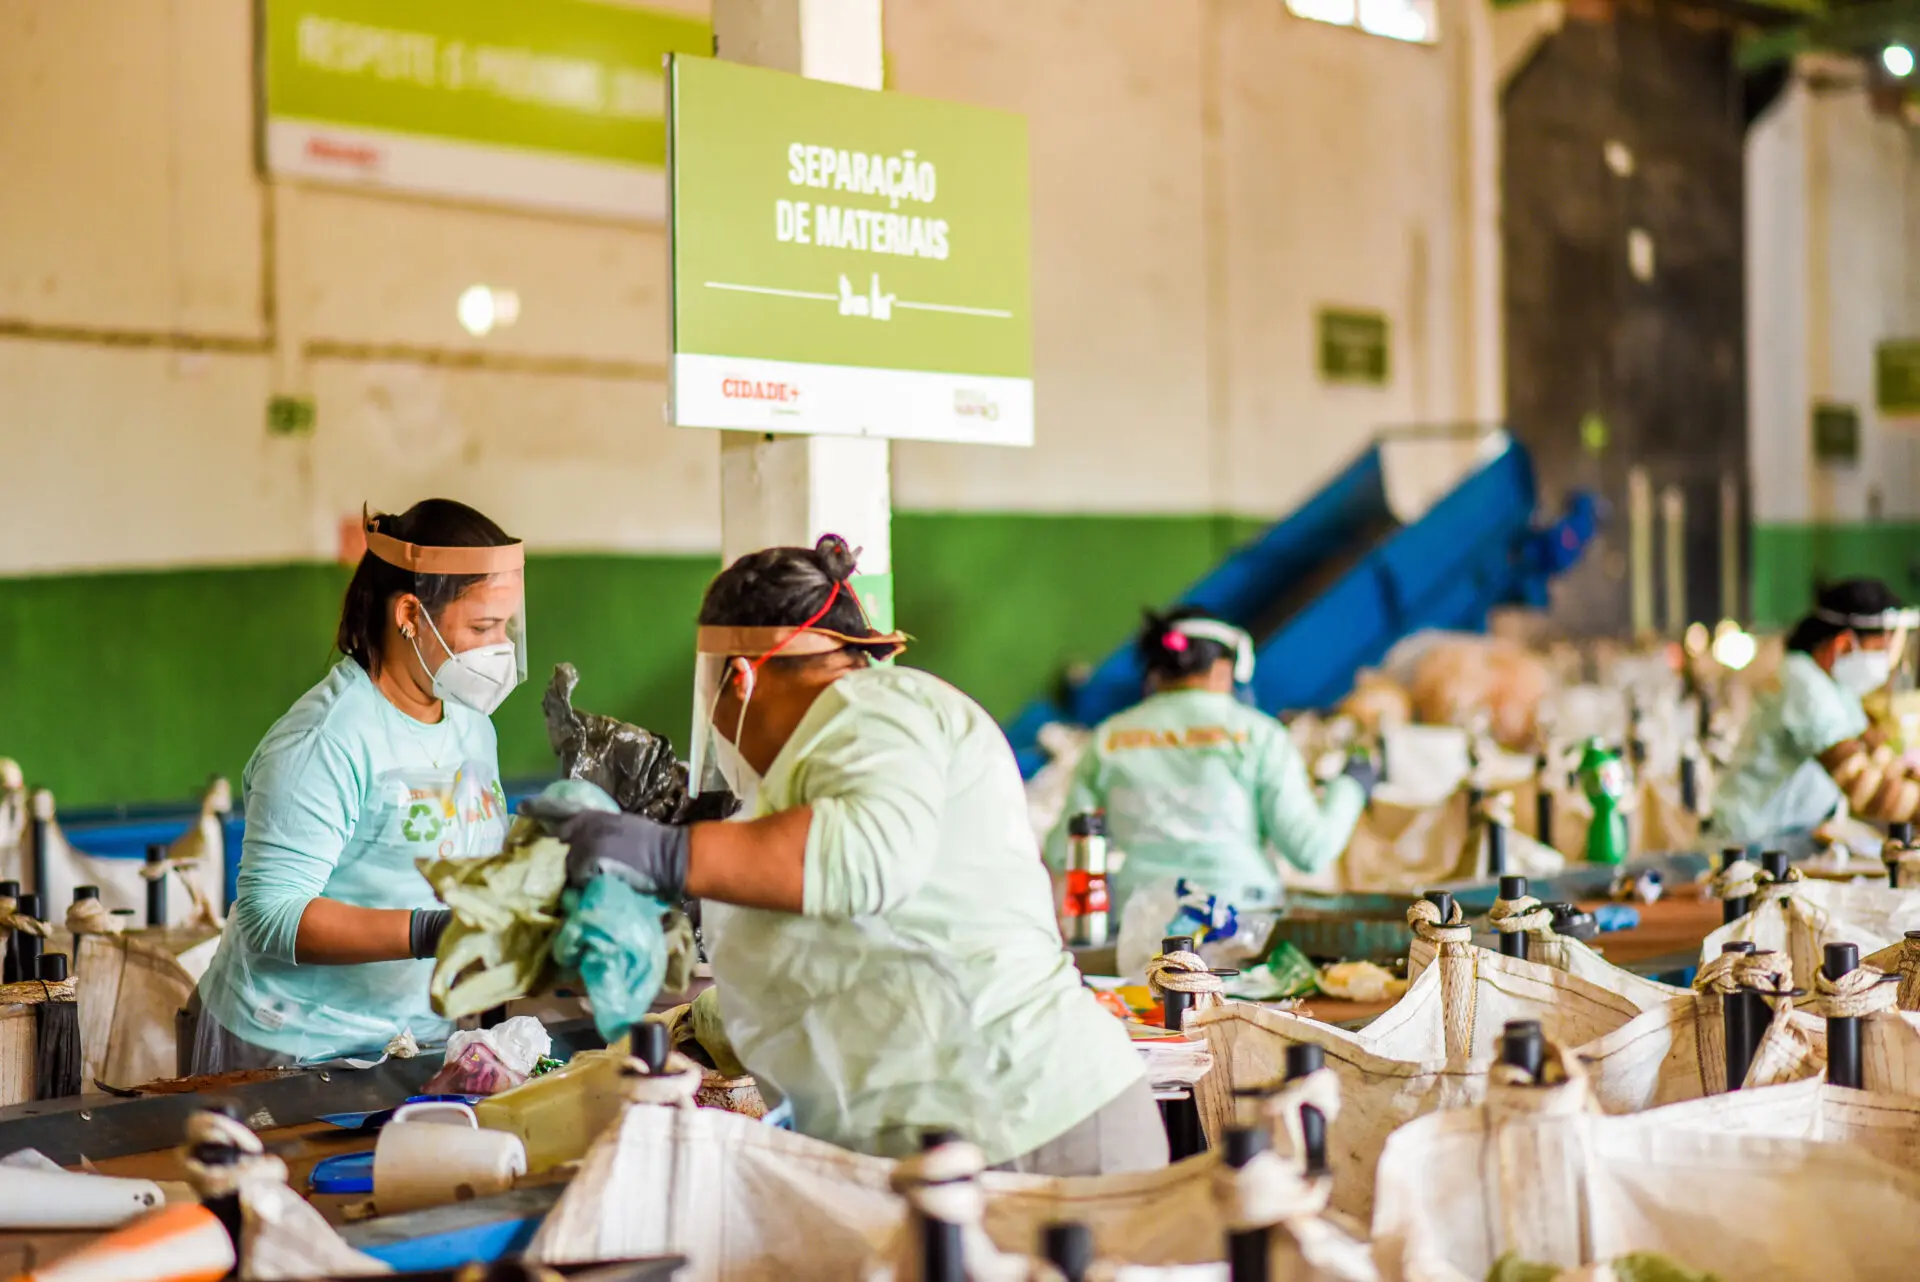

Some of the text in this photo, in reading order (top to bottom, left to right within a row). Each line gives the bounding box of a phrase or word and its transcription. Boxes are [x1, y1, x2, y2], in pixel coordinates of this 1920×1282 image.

[788, 142, 936, 209] SEPARAÇÃO
[775, 198, 950, 261] DE MATERIAIS
